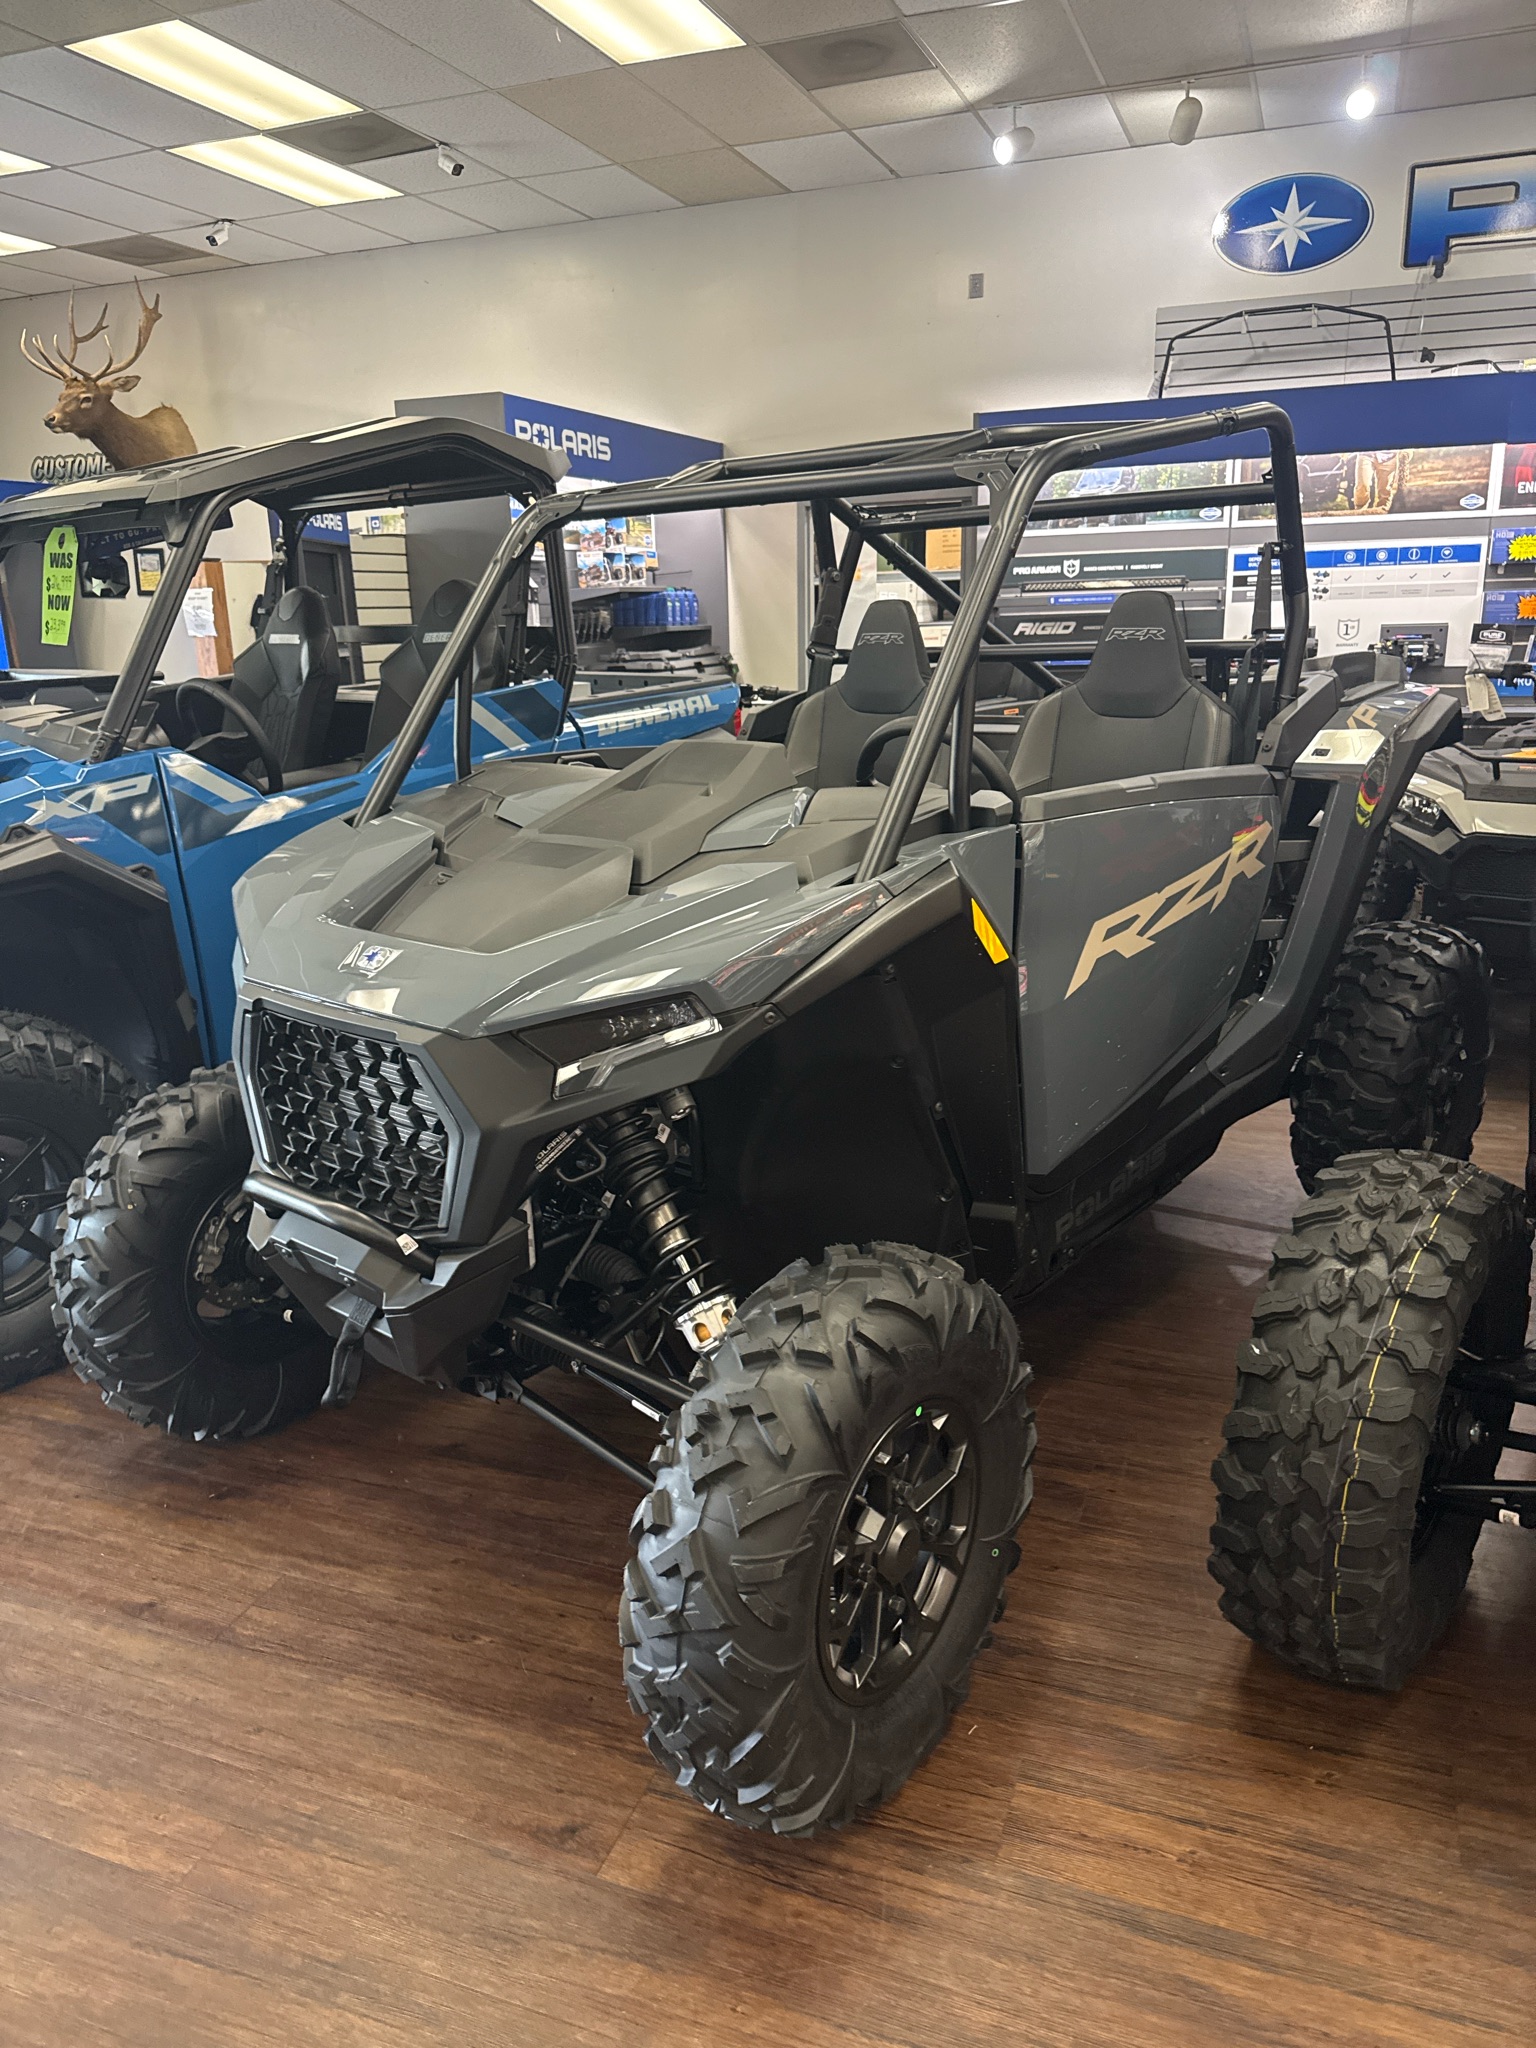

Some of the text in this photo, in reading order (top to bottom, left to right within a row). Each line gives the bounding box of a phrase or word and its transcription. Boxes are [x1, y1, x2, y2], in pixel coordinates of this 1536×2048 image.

[513, 418, 612, 462] POLARIS
[31, 452, 115, 483] CUSTOME
[49, 552, 74, 569] WAS
[47, 594, 71, 611] NOW
[424, 634, 451, 642] GENER
[857, 632, 905, 646] RZR
[1013, 621, 1077, 636] RIGID
[1105, 627, 1166, 642] RZR
[597, 693, 720, 738] GENERAL
[24, 773, 154, 826] XP
[1064, 820, 1274, 1001] RZR
[535, 1130, 568, 1161] OLARIS
[1055, 1141, 1168, 1245] POLARIS
